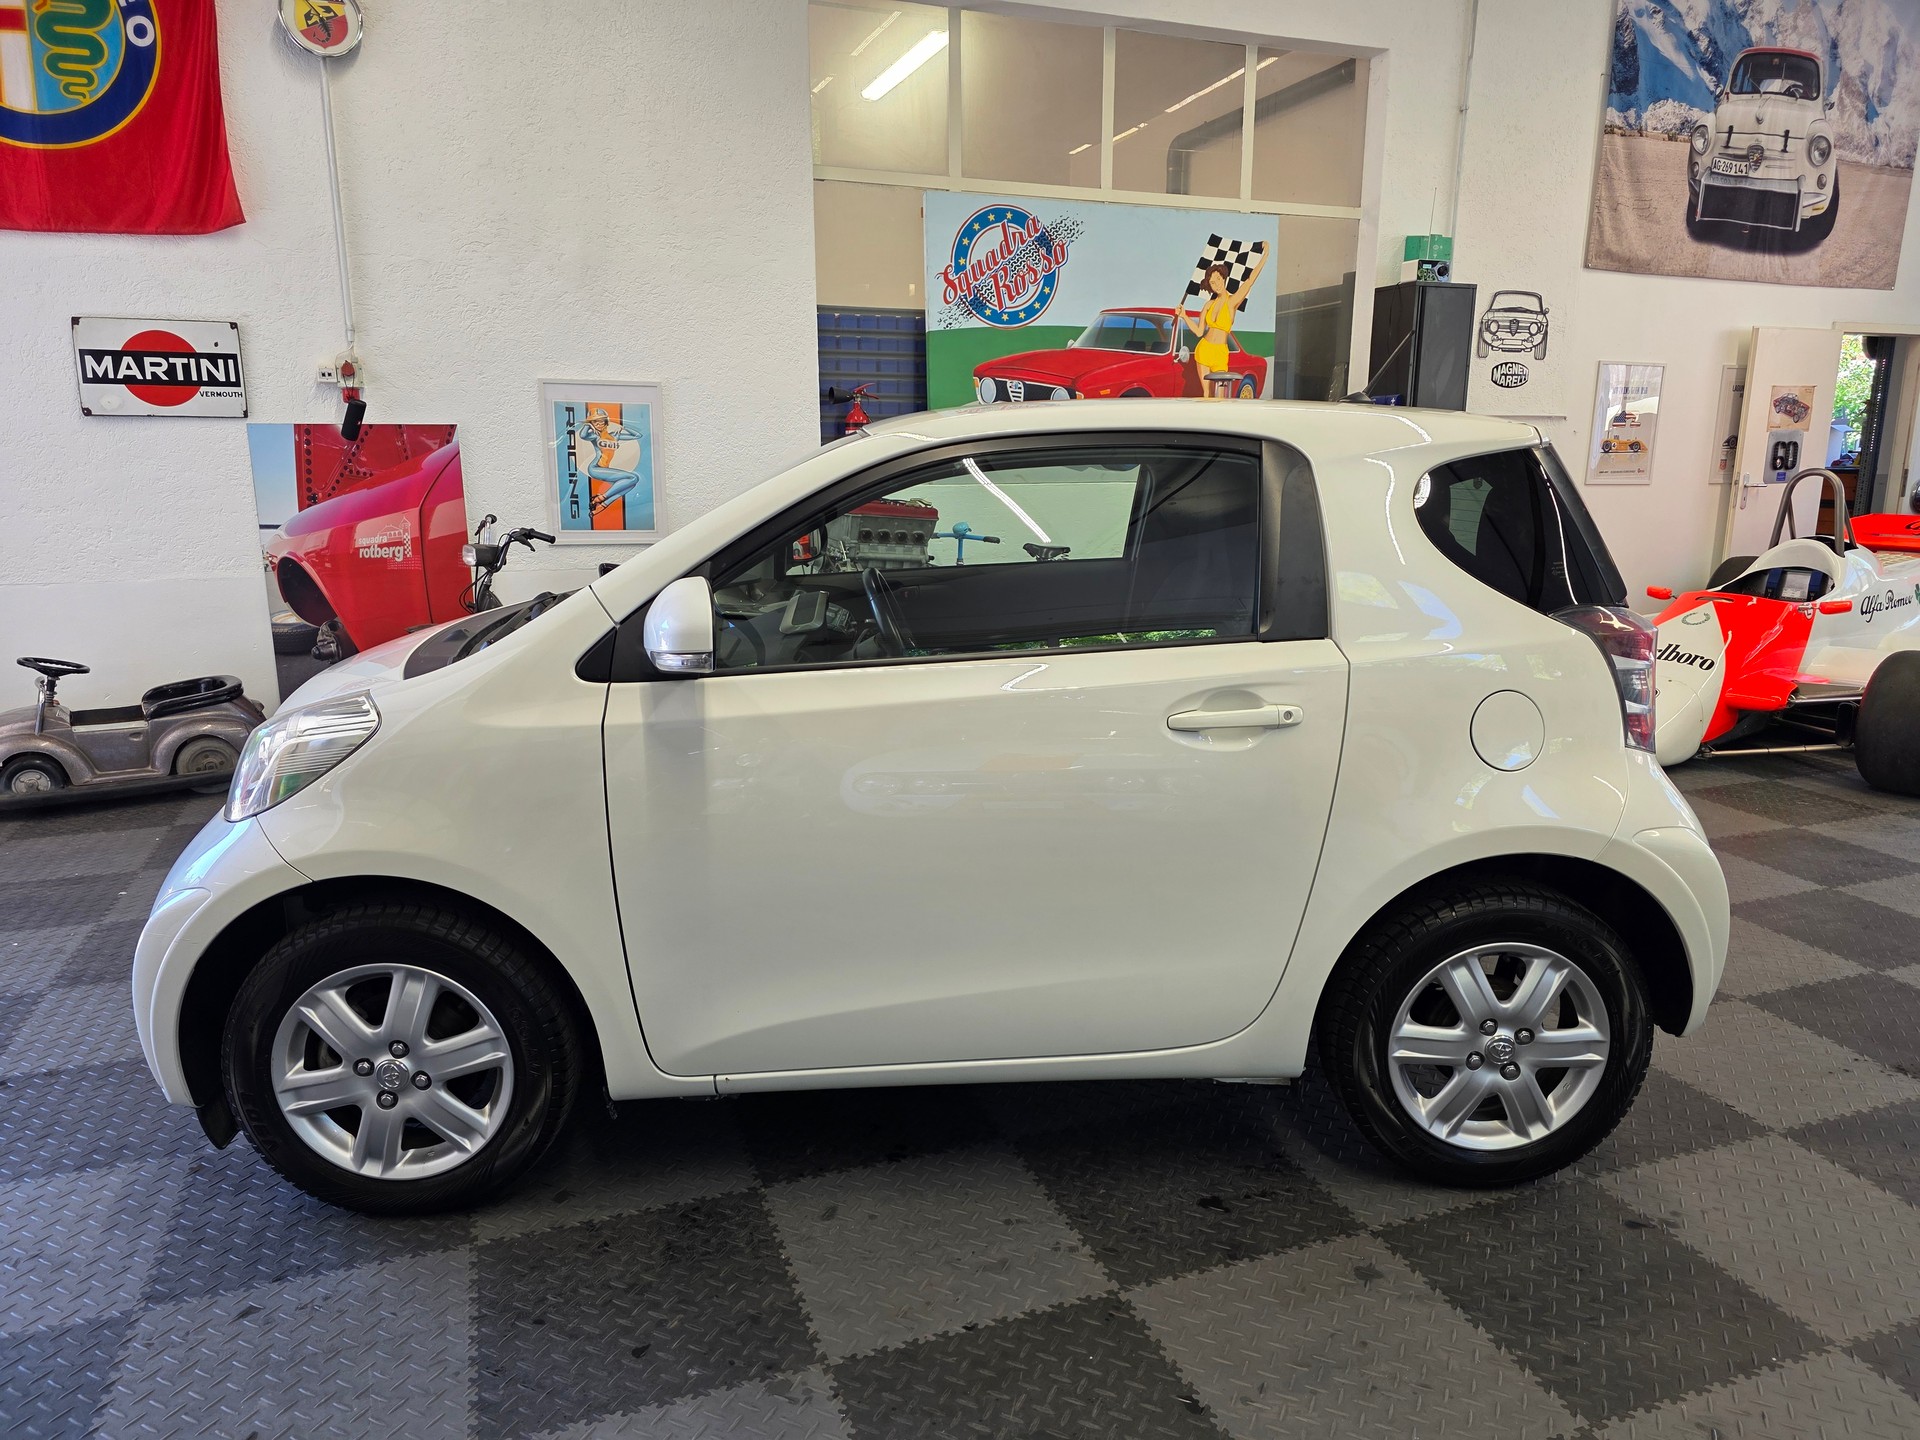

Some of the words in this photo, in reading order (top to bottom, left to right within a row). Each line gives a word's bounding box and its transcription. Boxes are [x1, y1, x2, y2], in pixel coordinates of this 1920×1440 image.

[938, 215, 1042, 305] Squadra
[989, 238, 1070, 312] Rosso
[84, 355, 236, 382] MARTINI
[199, 390, 243, 398] VERMOUTH
[598, 440, 620, 450] Gulf
[565, 406, 580, 519] RACING
[358, 534, 388, 546] squadra
[359, 545, 404, 561] rotberg
[1860, 594, 1884, 623] Alfa
